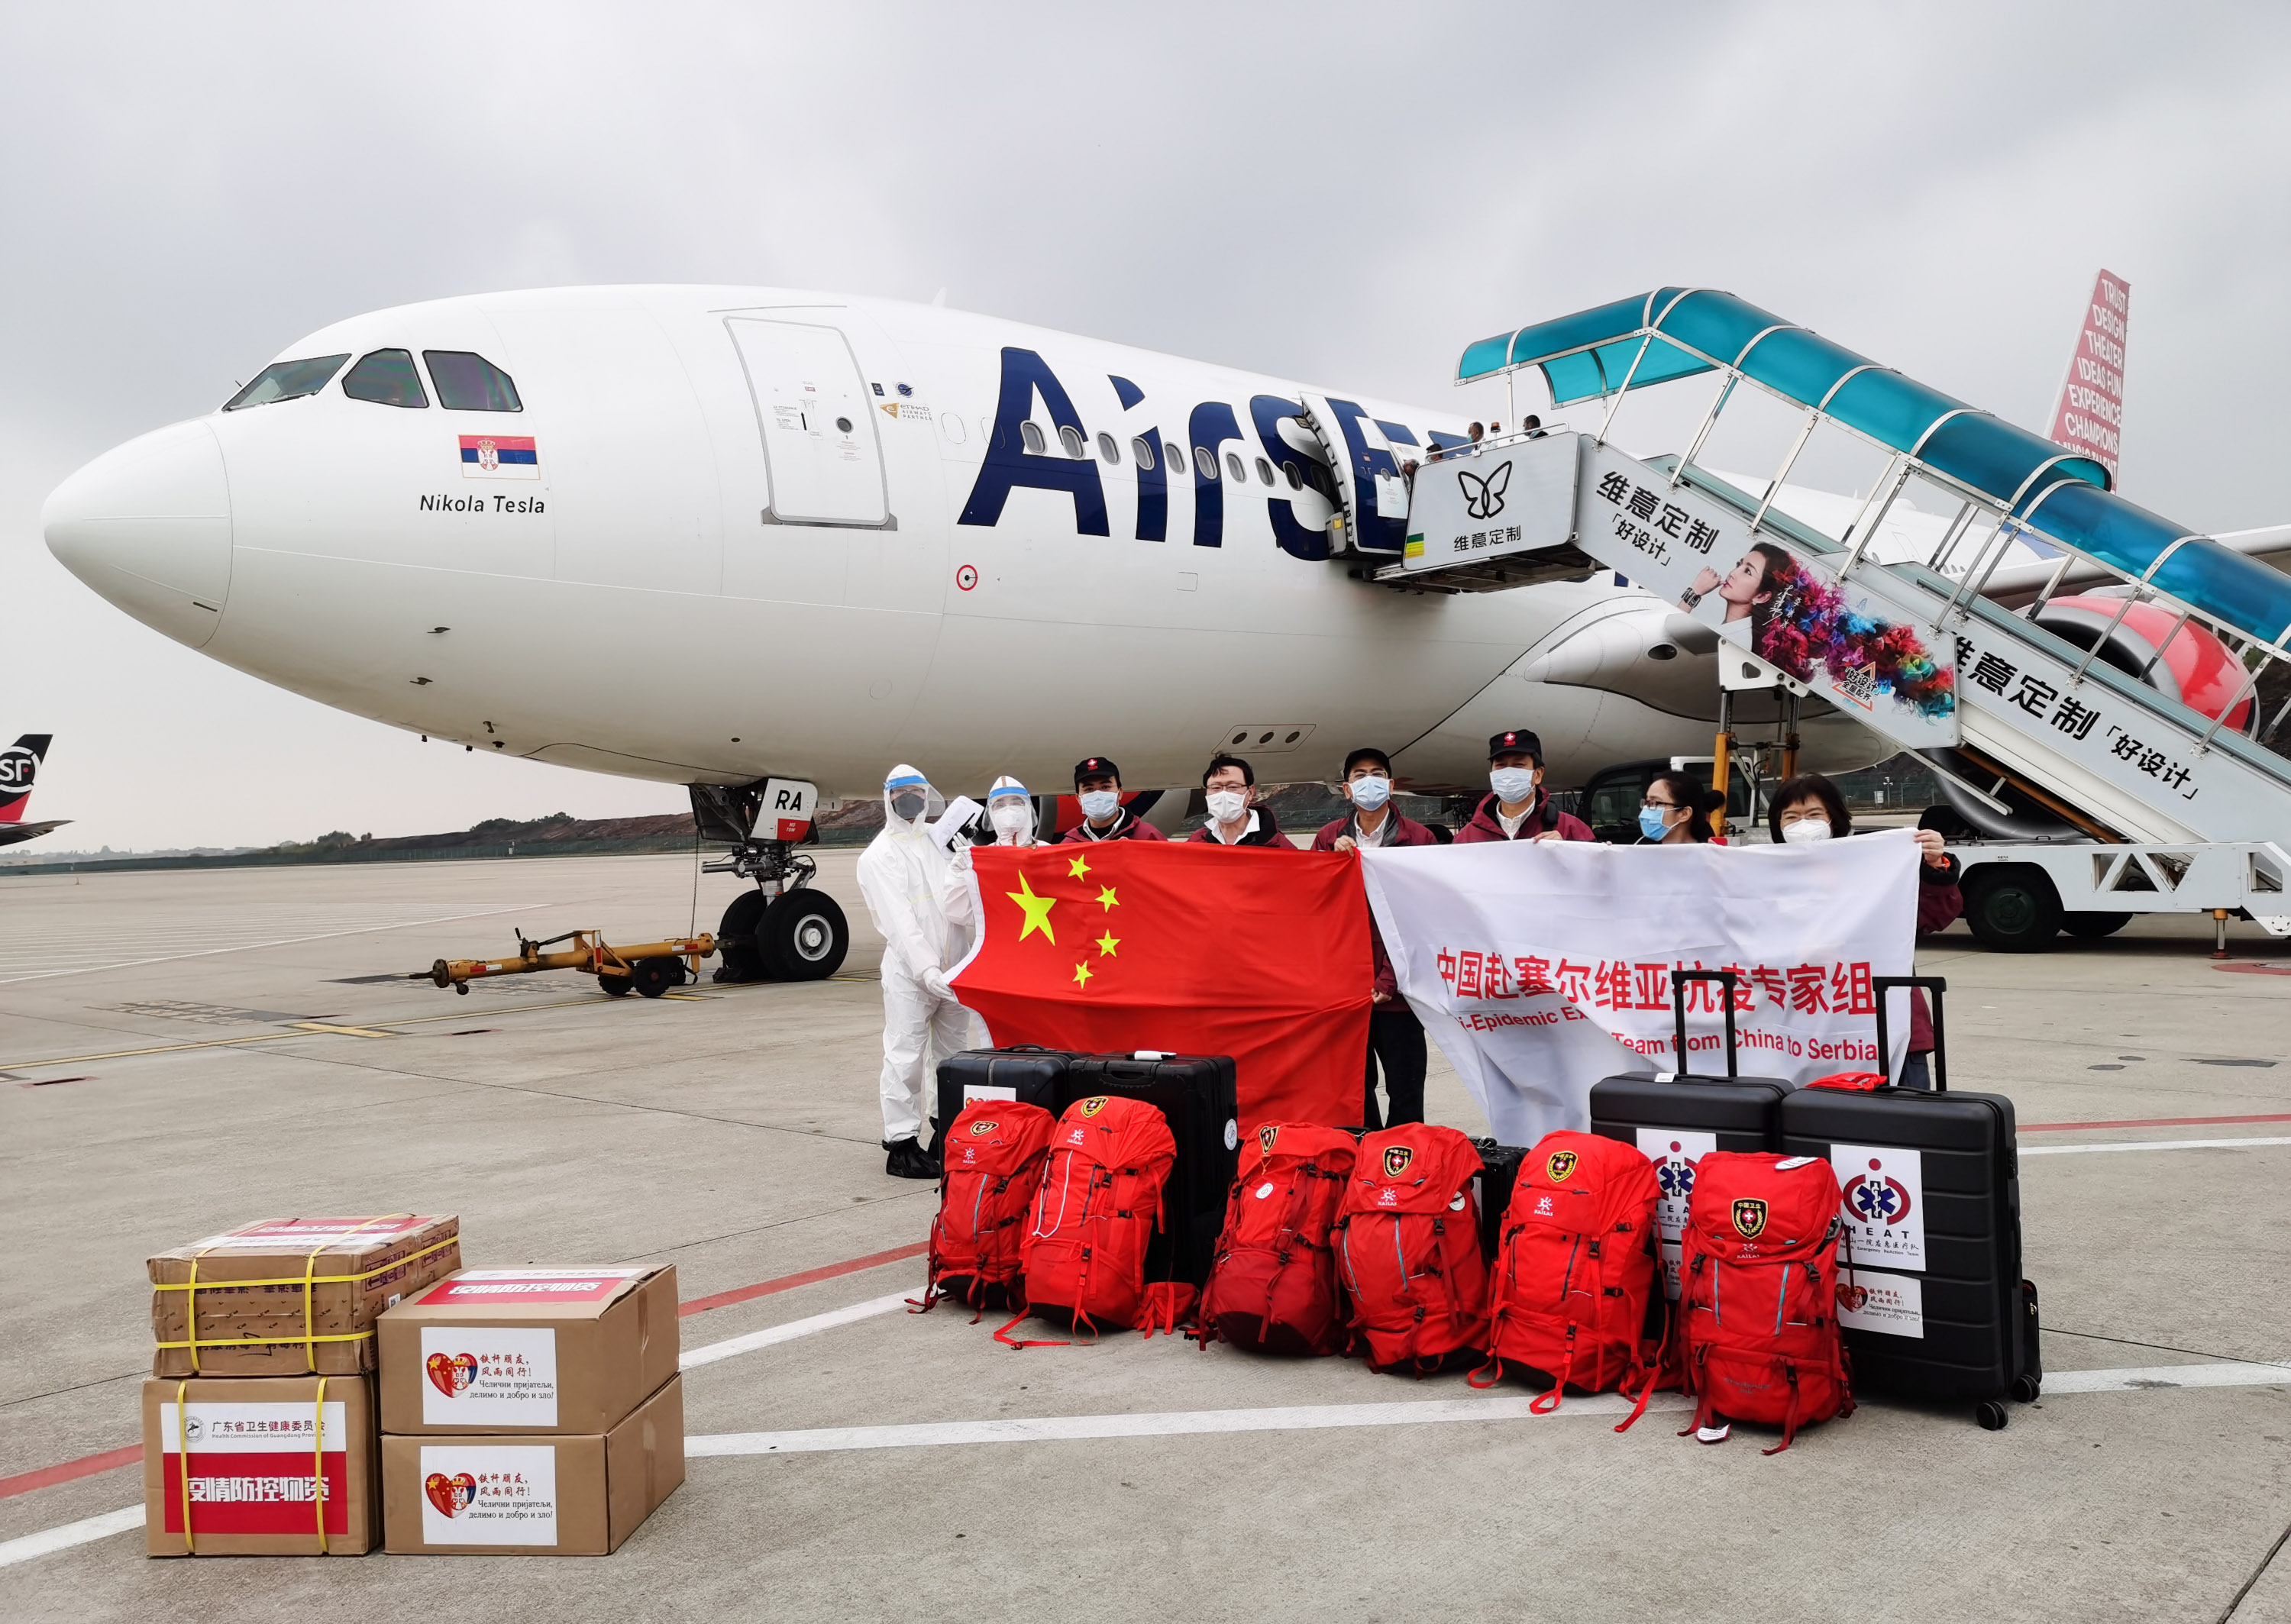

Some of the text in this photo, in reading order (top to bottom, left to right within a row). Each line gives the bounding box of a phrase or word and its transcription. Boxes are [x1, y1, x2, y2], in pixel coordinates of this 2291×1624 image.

[2101, 278, 2126, 315] TRUST
[2092, 304, 2125, 344] DESIGN
[2085, 329, 2123, 371] THEATER
[2076, 357, 2122, 399] IDEAS FUN
[2067, 383, 2121, 428] EXPERIENCE
[2064, 412, 2118, 456] CHAMPIONS
[956, 346, 1472, 562] AirSE
[419, 494, 544, 513] Nikola Tesla
[1596, 471, 1720, 555] 维意定制
[1453, 525, 1521, 553] 维意定制
[0, 758, 31, 781] SF
[774, 789, 802, 811] RA
[1437, 947, 1876, 1015] 中国赴塞尔维亚抗疫专家组
[1787, 1034, 1802, 1056] to
[1808, 1038, 1878, 1061] Serbia
[1848, 1225, 1909, 1239] HEAT
[480, 1380, 554, 1390] Челични пријатељи,
[506, 1392, 529, 1400] добро
[188, 1477, 329, 1502] 疫情防控物资
[478, 1500, 553, 1509] Челични пријатељи,
[506, 1511, 528, 1520] добро
